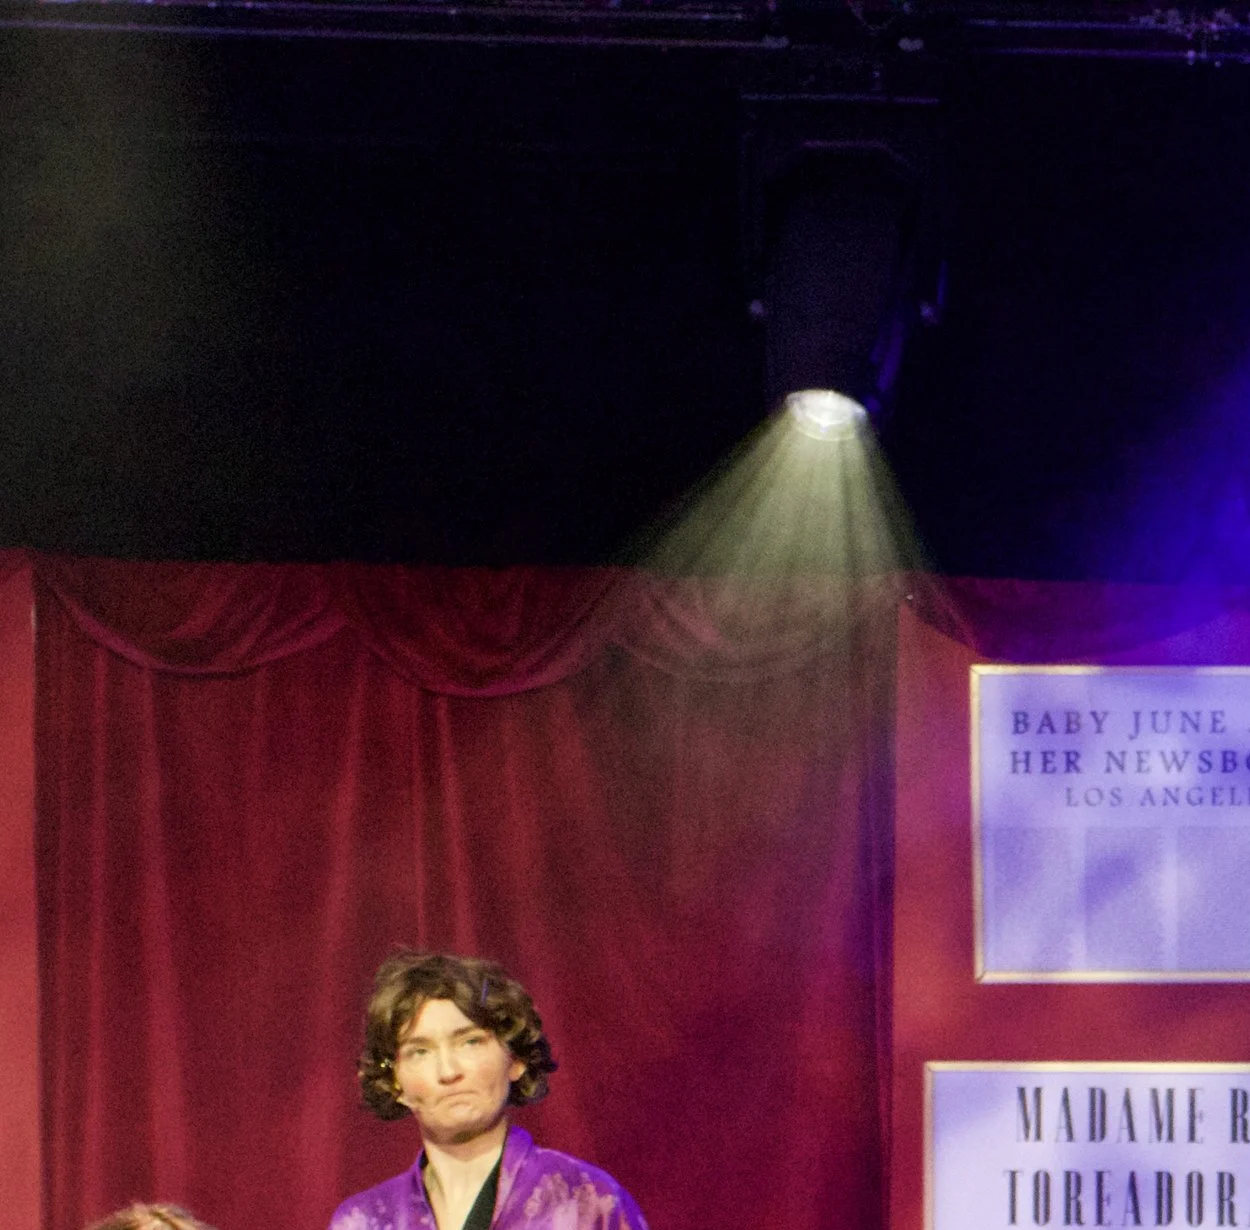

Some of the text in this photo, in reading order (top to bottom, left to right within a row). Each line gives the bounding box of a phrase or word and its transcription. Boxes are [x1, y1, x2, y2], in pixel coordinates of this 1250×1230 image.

[1011, 709, 1108, 736] BABY
[1128, 709, 1227, 738] JUNE
[1010, 749, 1084, 775] HER
[1066, 787, 1124, 808] LOS
[1016, 1085, 1206, 1144] MADAME
